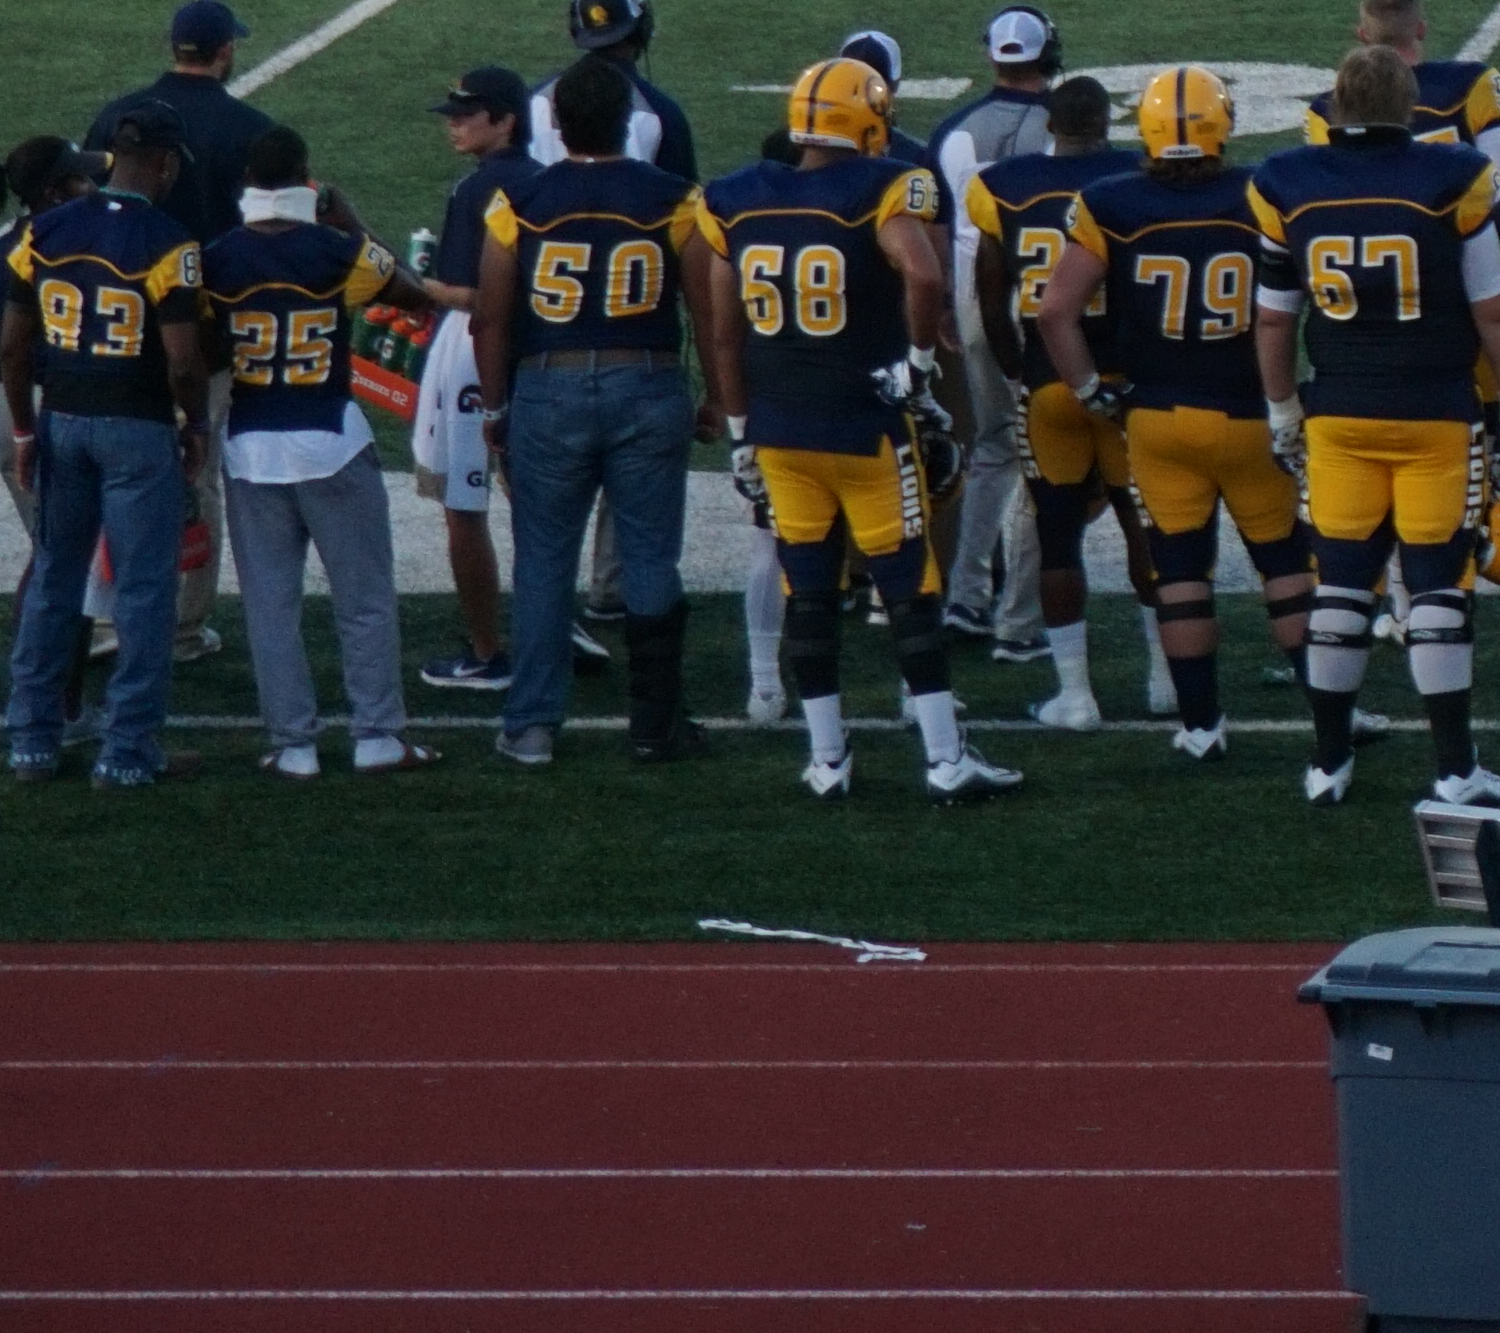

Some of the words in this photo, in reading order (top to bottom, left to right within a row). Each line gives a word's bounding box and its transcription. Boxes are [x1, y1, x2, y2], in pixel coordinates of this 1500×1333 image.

[530, 240, 664, 323] 50
[1134, 251, 1255, 341] 79
[1305, 233, 1422, 321] 67
[230, 307, 337, 385] 25
